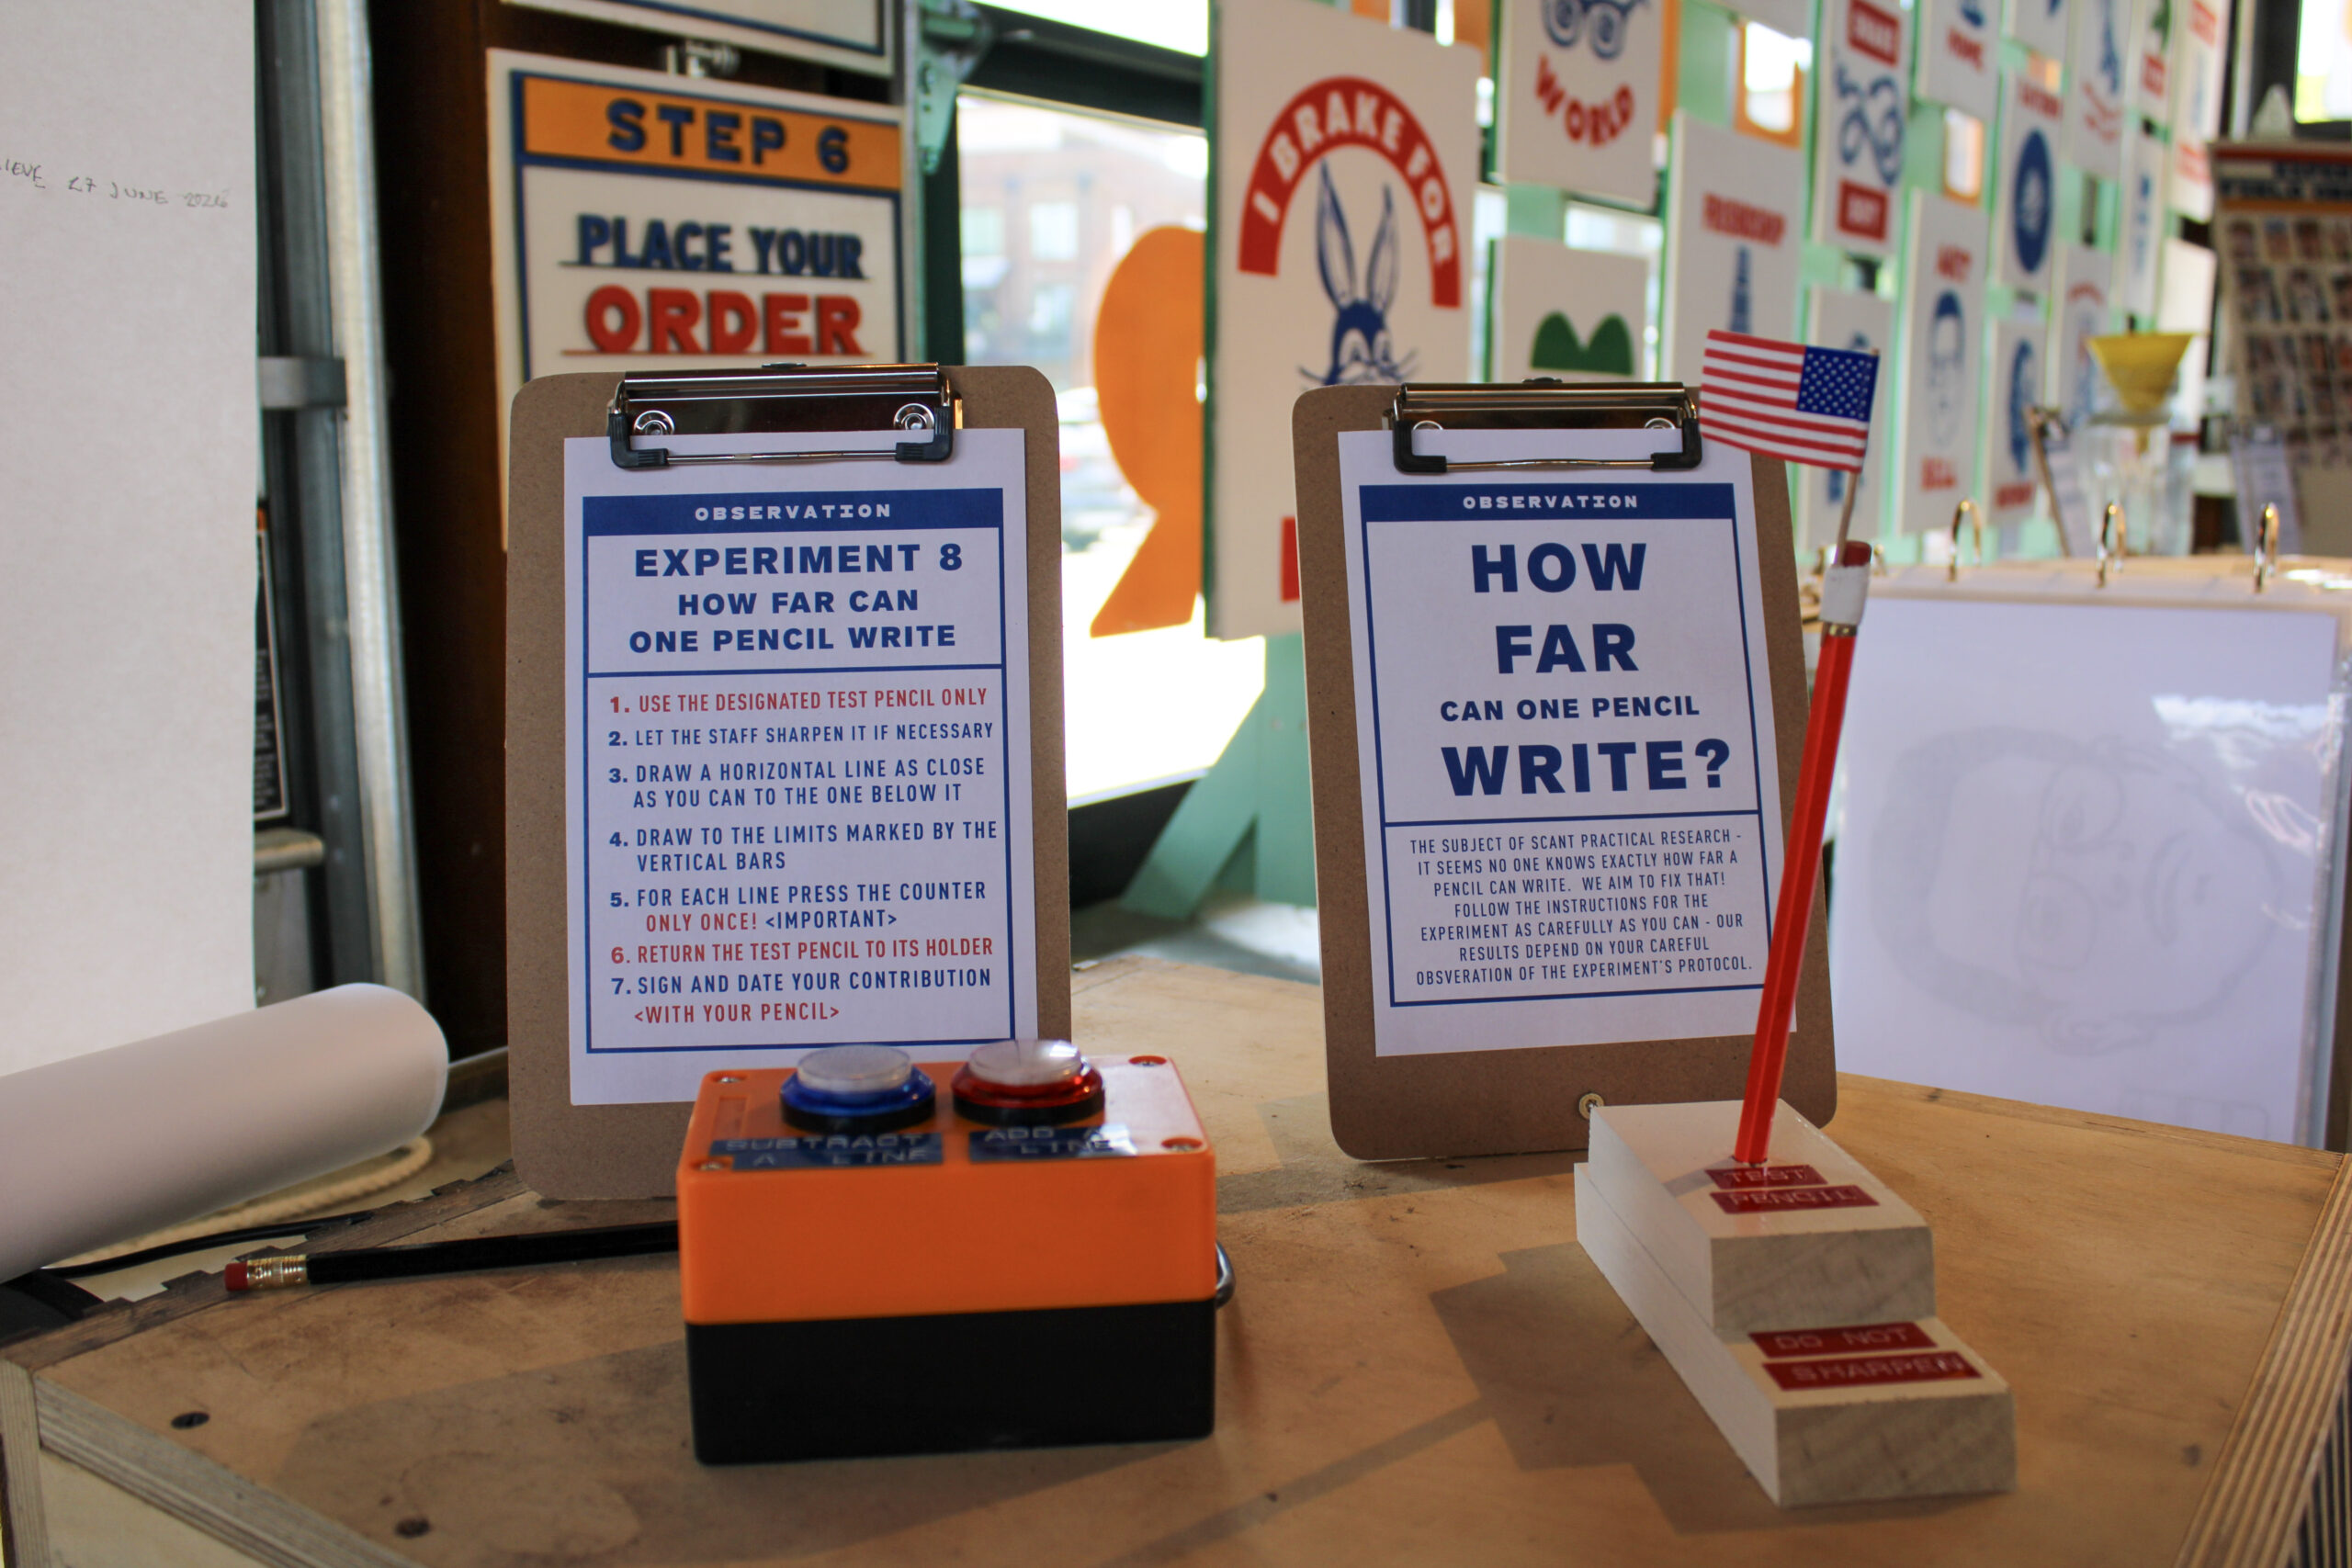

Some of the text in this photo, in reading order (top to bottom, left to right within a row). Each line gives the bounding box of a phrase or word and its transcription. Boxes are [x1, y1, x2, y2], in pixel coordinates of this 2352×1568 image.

[1535, 52, 1634, 147] WORLD
[606, 98, 849, 174] STEP 6
[1252, 90, 1454, 265] I BRAKE FOR
[110, 181, 168, 204] JUNE
[577, 213, 865, 279] PLACE YOUR
[584, 284, 864, 355] ORDER
[695, 504, 889, 521] OBSERVATION
[1464, 496, 1636, 509] OBSERVATION
[636, 544, 962, 577] EXPERIMENT 8
[1472, 543, 1646, 592] HOW
[679, 590, 917, 615] HOW FAR CAN
[629, 625, 955, 653] ONE PENCIL WRITE
[1496, 624, 1638, 673] FAR
[611, 688, 986, 713] 1. USE THE DESIGNATED TEST PENCIL ONLY
[1441, 696, 1700, 721] CAN ONE PENCIL
[609, 723, 992, 746] 2. LET THE STAFF SHARPEN IT IF NECESSARY
[609, 758, 984, 783] 3. DRAW A HORIZONTAL LINE AS CLOSE
[1441, 739, 1729, 795] WRITE?
[634, 784, 961, 807] AS YOU CAN TO THE ONE BELOW IT
[609, 821, 996, 847] 4. DRAW TO THE LIMITS MARKED BY THE
[1410, 840, 1435, 853] THE
[1442, 837, 1501, 852] SUBJECT
[1510, 837, 1524, 850] OF
[1532, 835, 1574, 850] SCANT
[1581, 832, 1655, 848] PRACTICAL
[1661, 829, 1730, 844] RESEARCH
[638, 852, 785, 872] VERTICAL BARS
[1419, 851, 1737, 875] IT SEEMS NO ONE KNOWS EXACTLY HOW FAR A
[611, 882, 985, 907] 5. FOR EACH LINE PRESS THE COUNTER
[1434, 872, 1724, 897] PENCIL CAN WRITE. WE AIM TO FIX THAT!
[1455, 894, 1708, 918] FOLLOW THE INSTRUCTIONS FOR THE
[647, 909, 897, 931] ONLY ONCE! <IMPORTANT>
[1421, 924, 1508, 941] EXPERIMENT
[1515, 923, 1532, 937] AS
[1539, 919, 1612, 936] CAREFULLY
[1620, 919, 1635, 932] AS
[1642, 917, 1666, 931] YOU
[1674, 916, 1698, 930] CAN
[1717, 914, 1742, 928] OUR
[612, 938, 992, 964] 6. RETURN THE TEST PENCIL TO ITS HOLDER
[1460, 937, 1709, 961] RESULTS DEPEND ON YOUR CAREFUL
[612, 969, 989, 995] 7. SIGN AND DATE YOUR CONTRIBUTION
[1417, 967, 1511, 985] OBSVERATION
[1520, 966, 1534, 980] OF
[1542, 964, 1566, 979] THE
[1679, 956, 1751, 973] PROTOCOL.
[635, 1002, 839, 1023] <WITH YOUR PENCIL>
[726, 1134, 922, 1151] SUBTRACT
[985, 1126, 1055, 1142] ADD
[832, 1148, 928, 1166] LINE
[1726, 1168, 1807, 1183] TEST
[1728, 1190, 1857, 1206] PENCIL
[1774, 1326, 1909, 1349] DO NOT
[1793, 1356, 1964, 1382] SHARPEN
